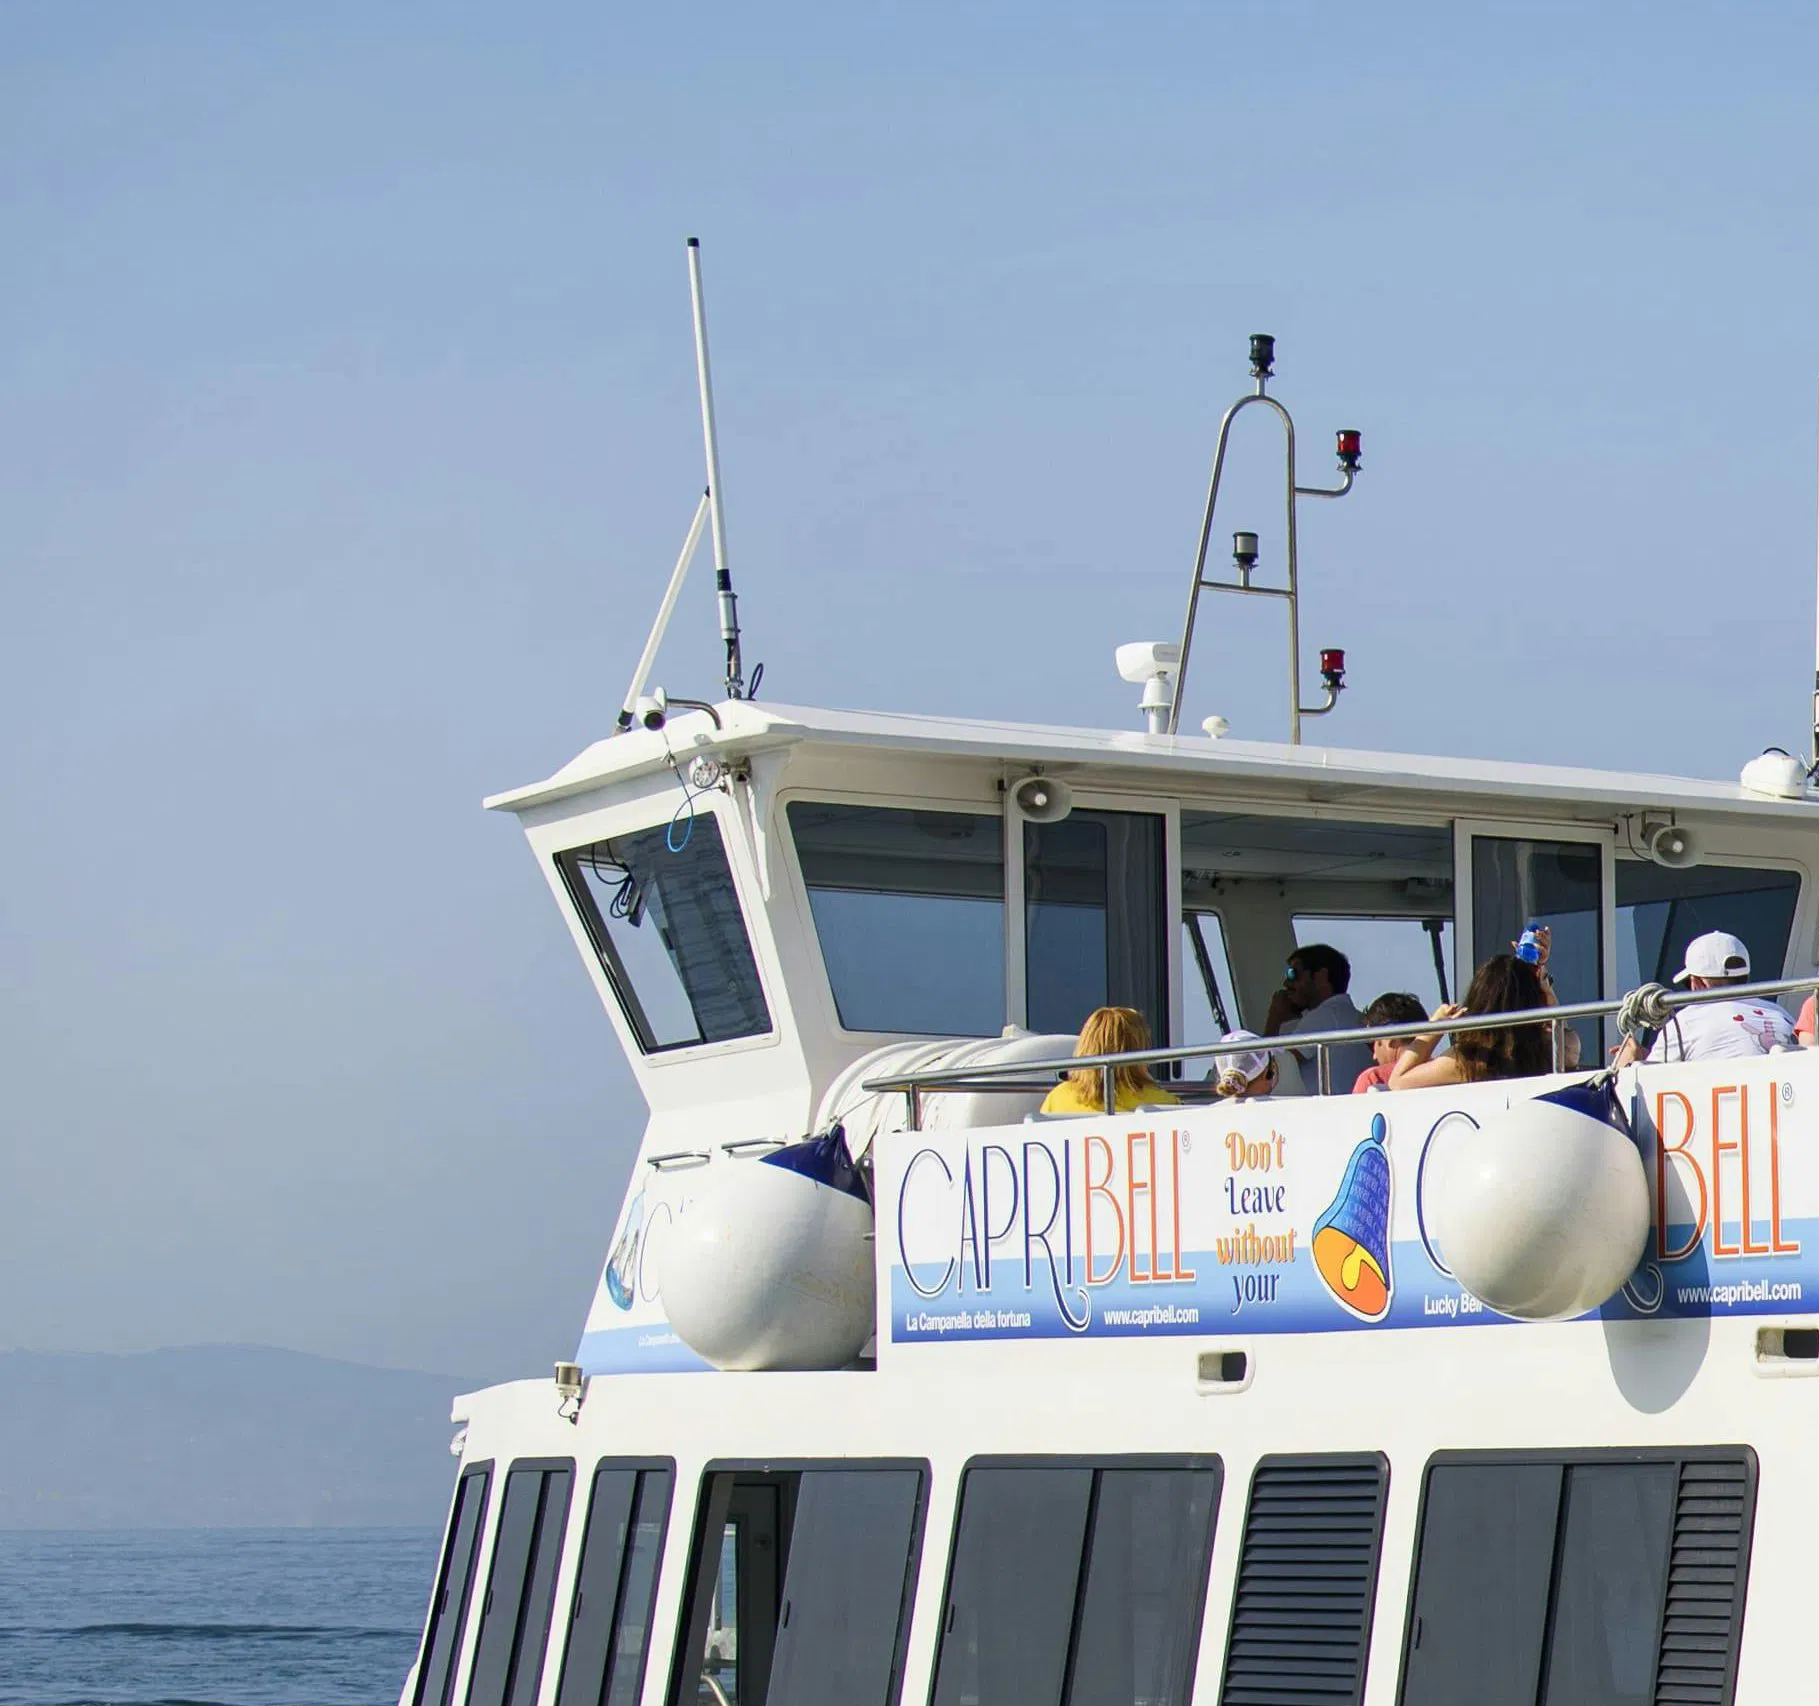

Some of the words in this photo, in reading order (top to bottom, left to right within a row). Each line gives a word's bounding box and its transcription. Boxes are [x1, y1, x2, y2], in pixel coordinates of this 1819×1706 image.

[1225, 1130, 1285, 1172] Don't
[1224, 1176, 1285, 1215] Leave
[898, 1130, 1195, 1330] CAPRIBELL
[1216, 1223, 1297, 1267] without
[1231, 1273, 1279, 1315] your
[1424, 1294, 1458, 1318] Lucky
[1677, 1280, 1801, 1306] www.capribell.com
[907, 1313, 919, 1331] La
[919, 1309, 972, 1333] Campanella
[973, 1308, 996, 1328] della
[997, 1308, 1031, 1328] fortuna
[1104, 1305, 1198, 1328] www.capribell.com
